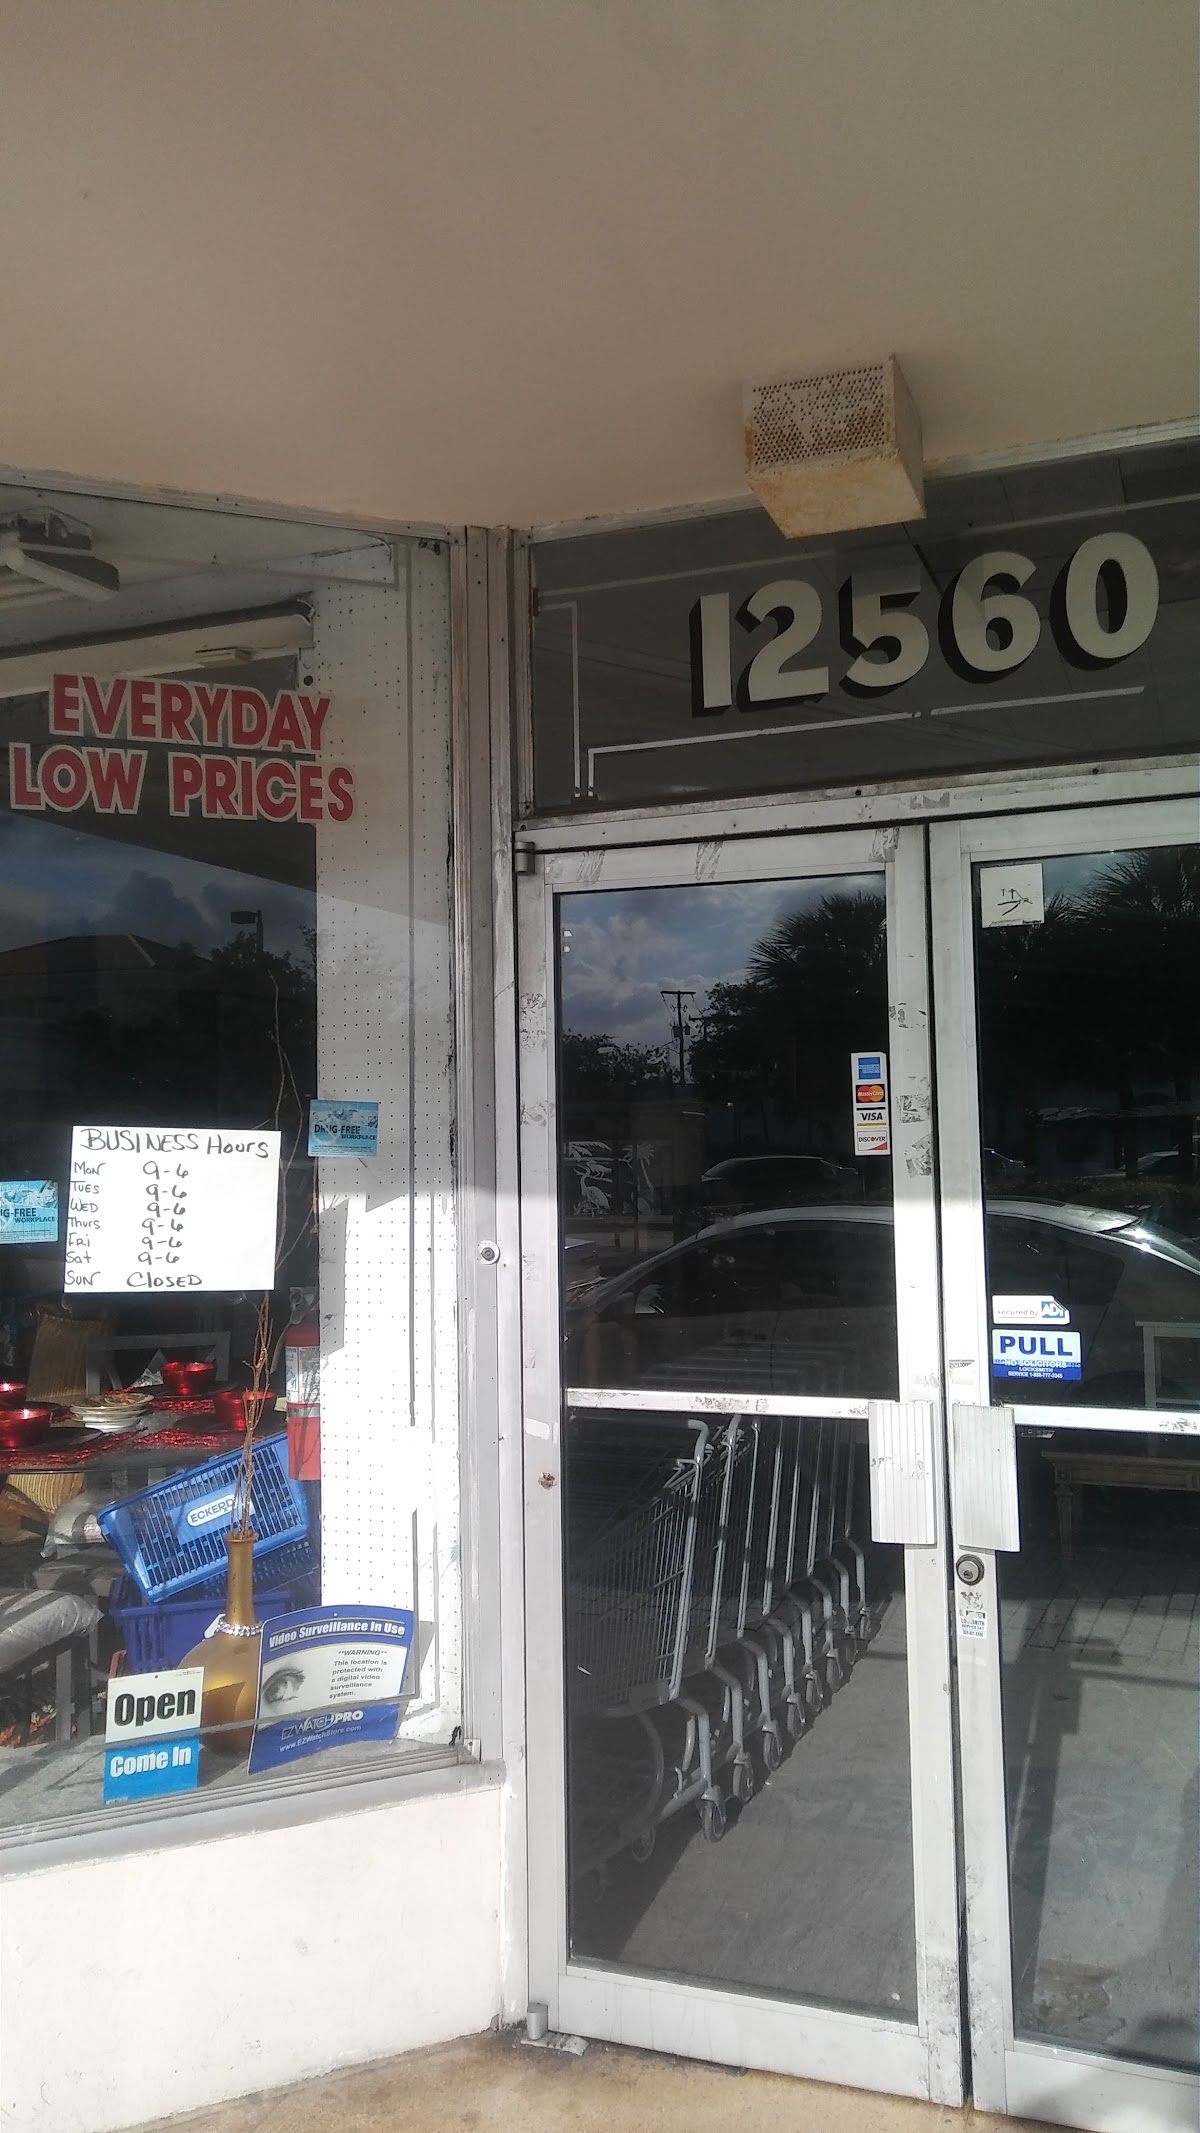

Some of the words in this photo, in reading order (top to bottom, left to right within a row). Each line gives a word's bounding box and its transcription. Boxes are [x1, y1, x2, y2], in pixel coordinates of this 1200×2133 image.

[691, 532, 1160, 717] 12560
[51, 673, 332, 752] EVERYDAY
[9, 742, 148, 814] LOW
[168, 752, 355, 823] PRICES
[860, 1112, 883, 1121] VISA
[80, 1128, 199, 1153] BUSINESS
[206, 1137, 269, 1158] Hours
[999, 1335, 1073, 1357] PULL
[1004, 1359, 1019, 1367] NO
[1019, 1360, 1067, 1369] SOLICITORS
[190, 1498, 236, 1523] ECKERD
[269, 1630, 297, 1649] Video
[298, 1620, 369, 1639] Surveillance
[370, 1621, 383, 1633] In
[383, 1622, 405, 1636] Use
[332, 1667, 366, 1676] protected
[330, 1682, 373, 1691] surveillance
[114, 1688, 197, 1728] Open
[279, 1725, 362, 1752] www.EZWatchStore.com
[109, 1751, 169, 1778] Come
[171, 1745, 192, 1767] In
